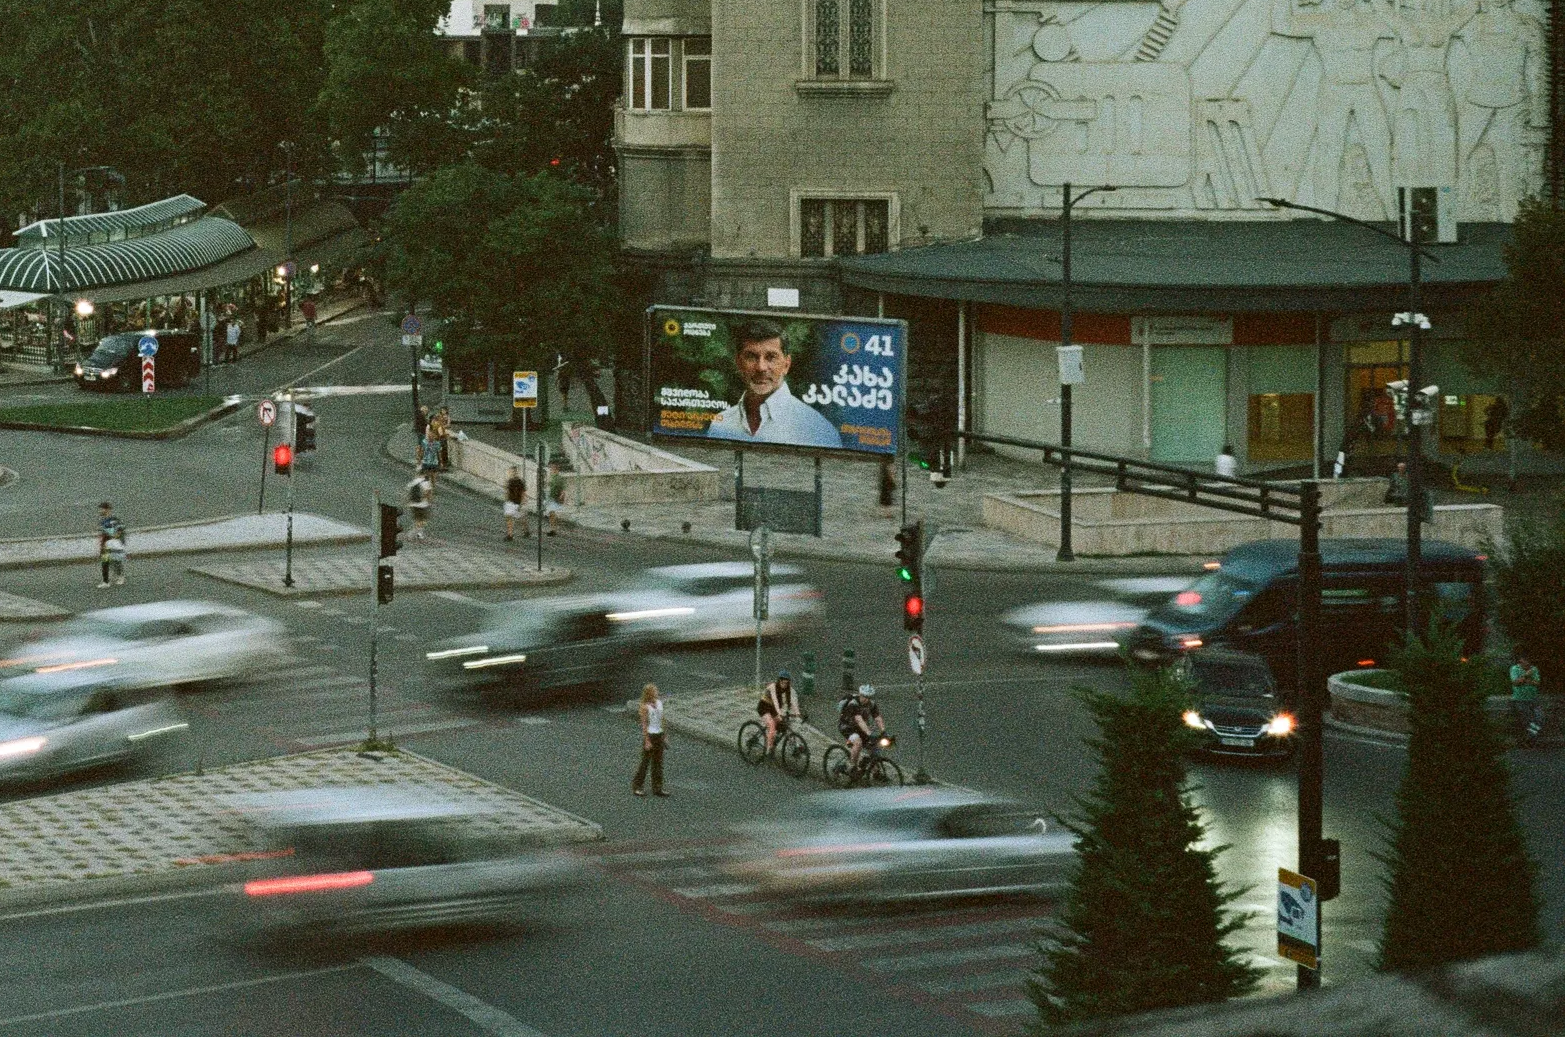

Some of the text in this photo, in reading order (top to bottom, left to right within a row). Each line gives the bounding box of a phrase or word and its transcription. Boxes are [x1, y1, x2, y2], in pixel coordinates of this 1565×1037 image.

[864, 335, 894, 357] 41
[833, 364, 894, 388] კახა
[802, 383, 893, 410] კალაძე
